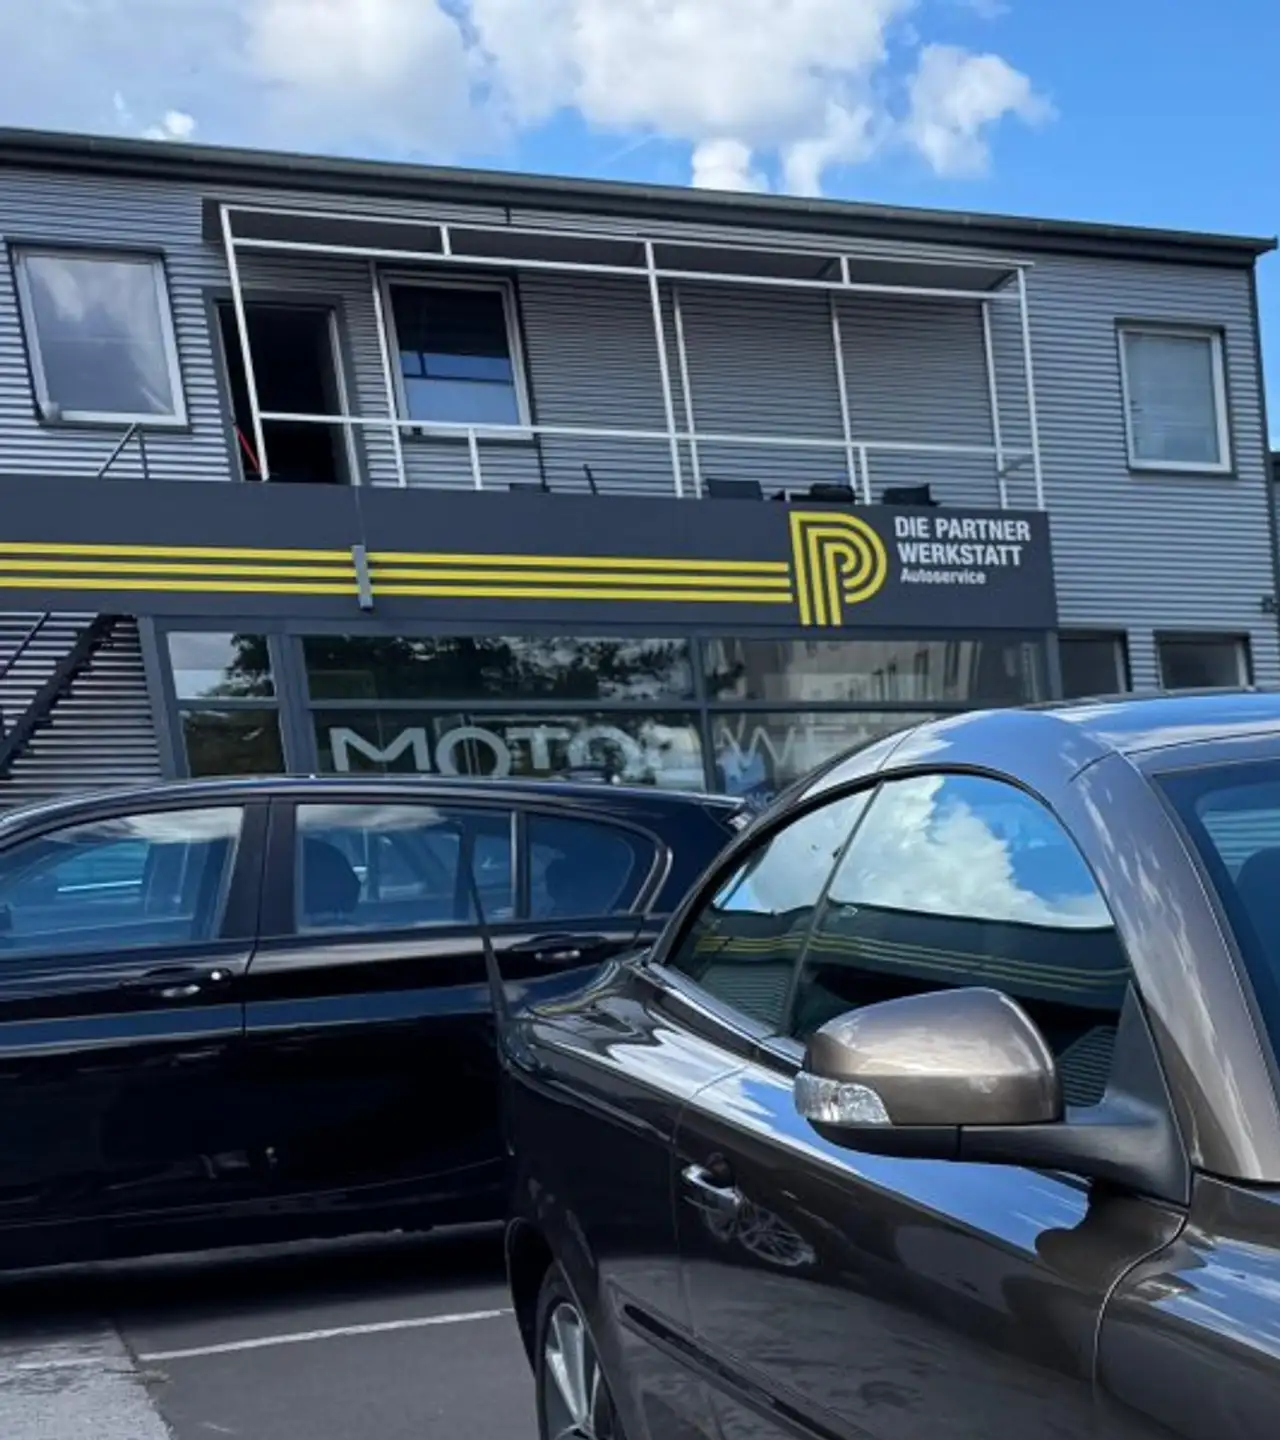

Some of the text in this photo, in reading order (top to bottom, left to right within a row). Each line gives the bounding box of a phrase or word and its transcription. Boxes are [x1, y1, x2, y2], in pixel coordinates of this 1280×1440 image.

[894, 516, 1031, 541] DIE PARTNER
[897, 543, 1023, 566] WERKSTATT
[901, 568, 987, 585] Autoservice
